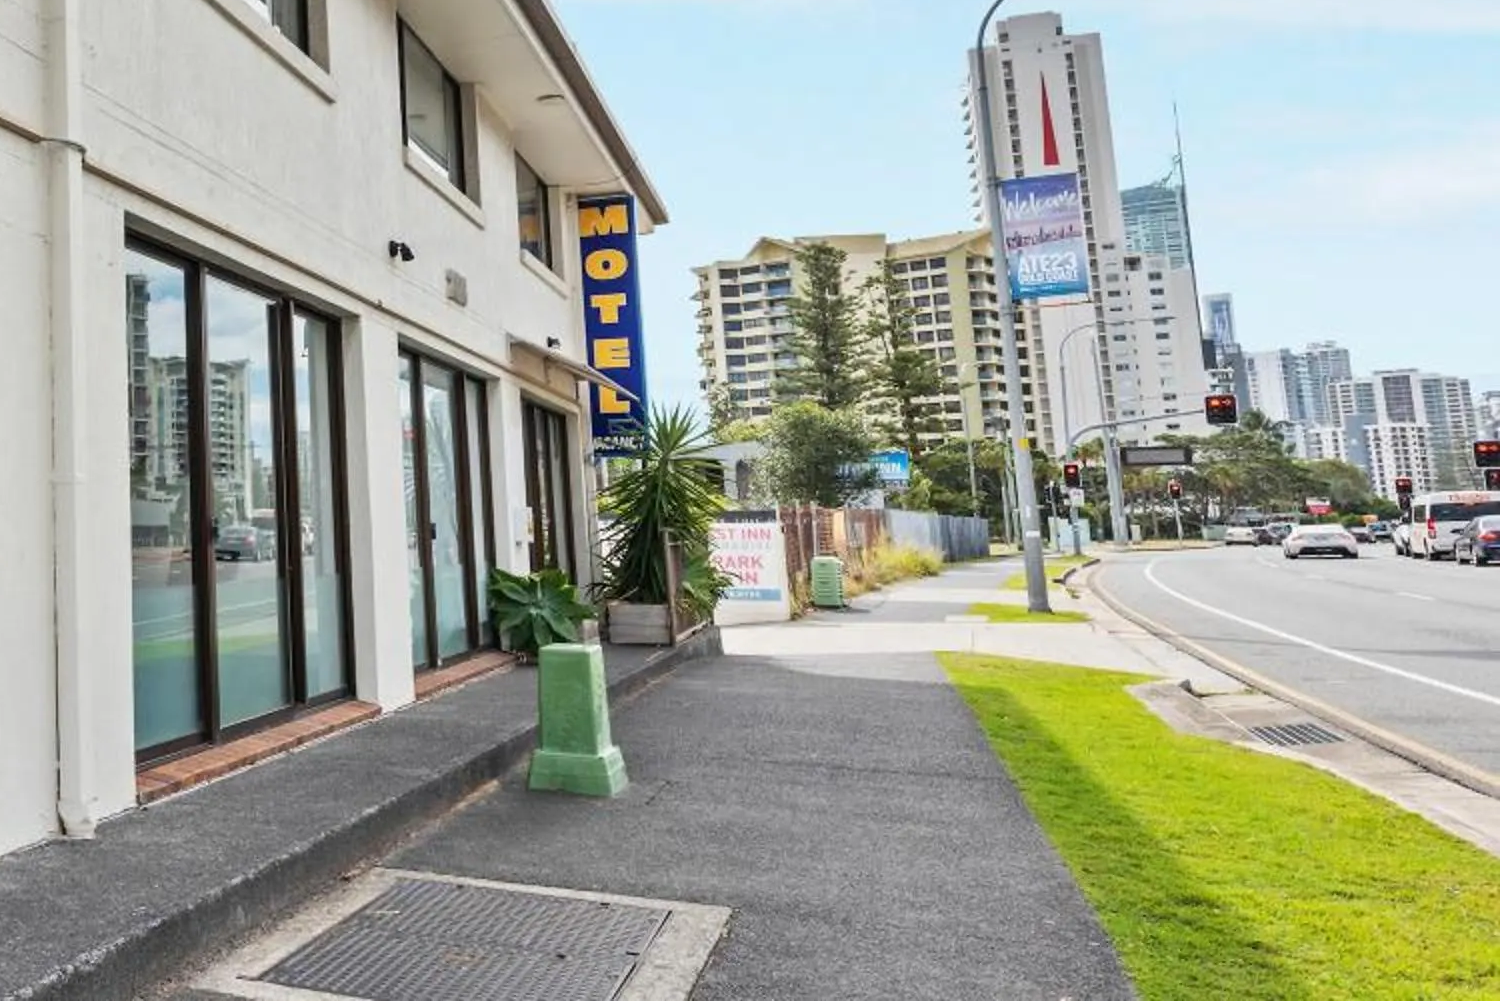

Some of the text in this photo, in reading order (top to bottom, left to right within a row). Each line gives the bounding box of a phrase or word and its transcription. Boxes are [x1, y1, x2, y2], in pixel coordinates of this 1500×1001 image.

[1000, 189, 1079, 221] Welcome
[1019, 252, 1077, 276] ATE23
[579, 204, 630, 414] MOTEL
[741, 527, 771, 540] INN
